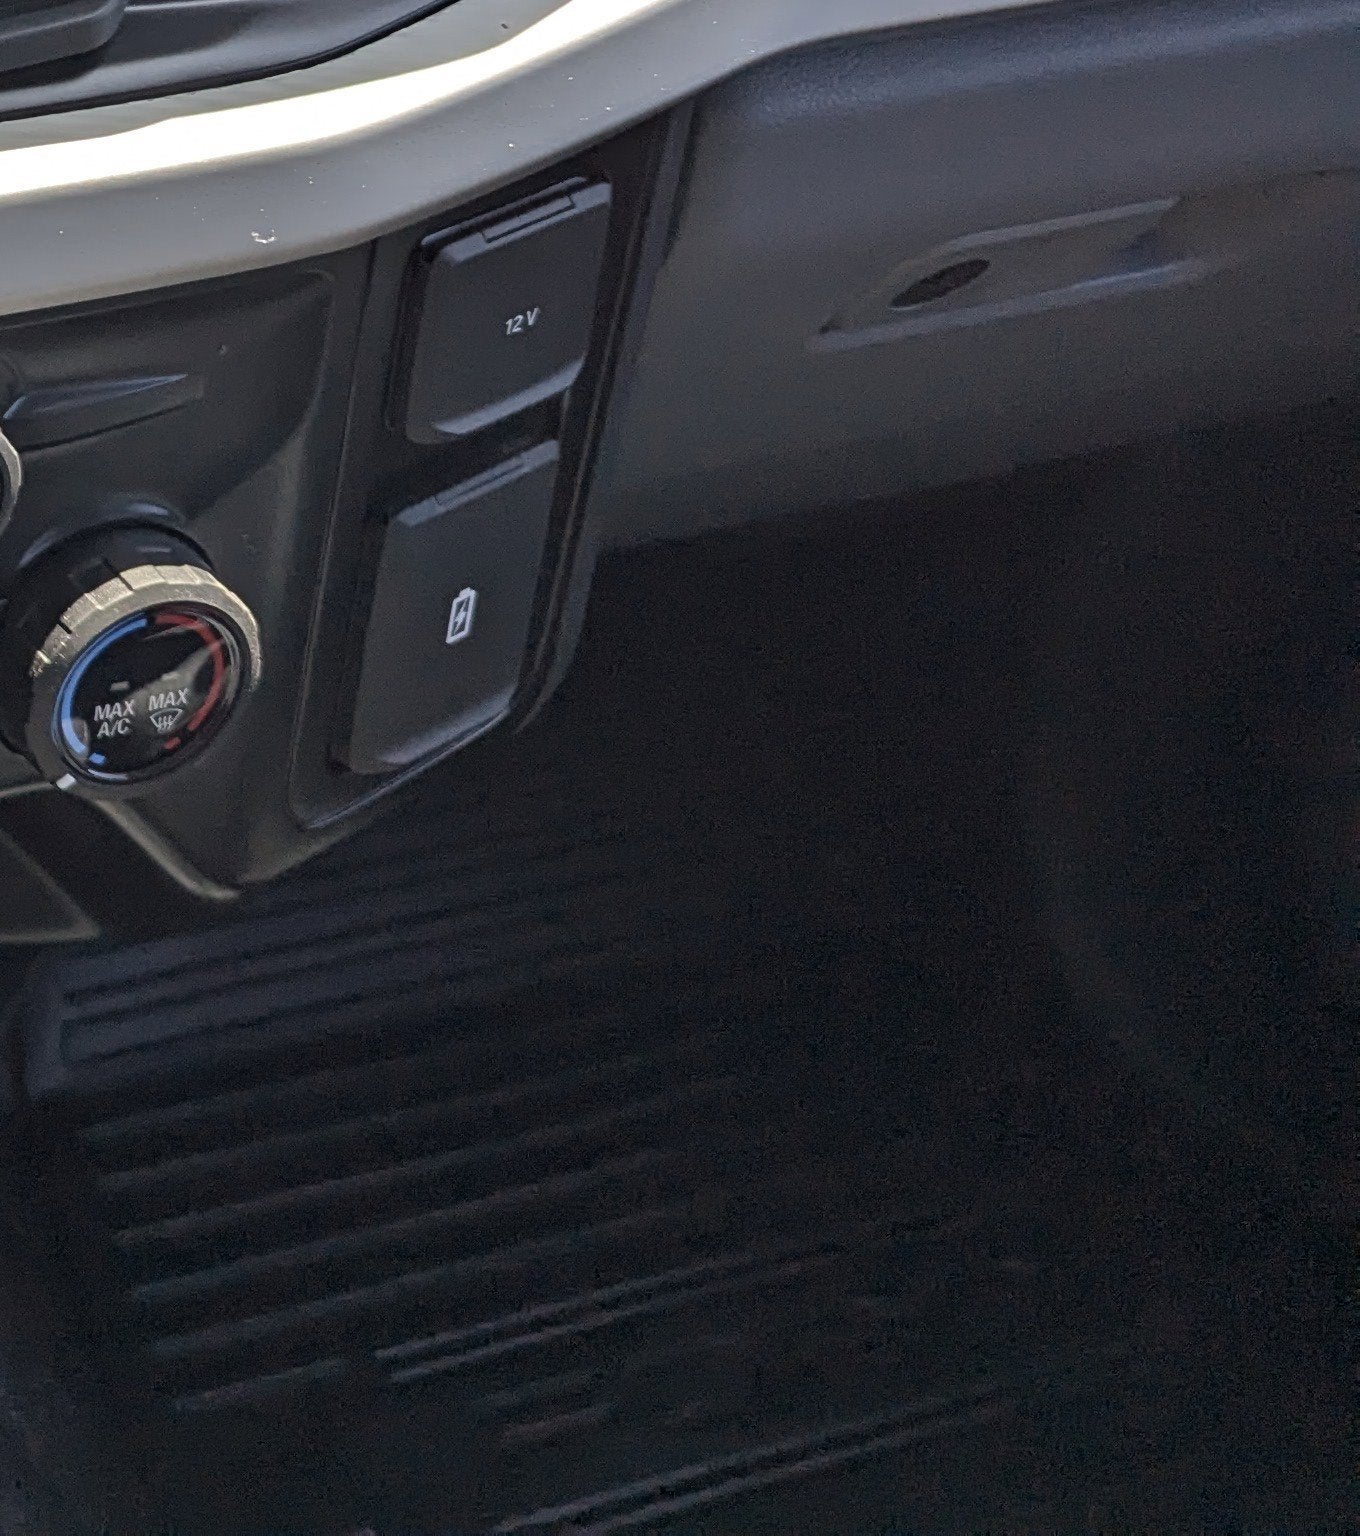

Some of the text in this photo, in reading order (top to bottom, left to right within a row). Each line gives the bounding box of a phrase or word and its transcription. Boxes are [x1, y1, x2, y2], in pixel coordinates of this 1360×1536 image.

[93, 687, 191, 722] MAX MAX
[96, 717, 132, 739] A/C
